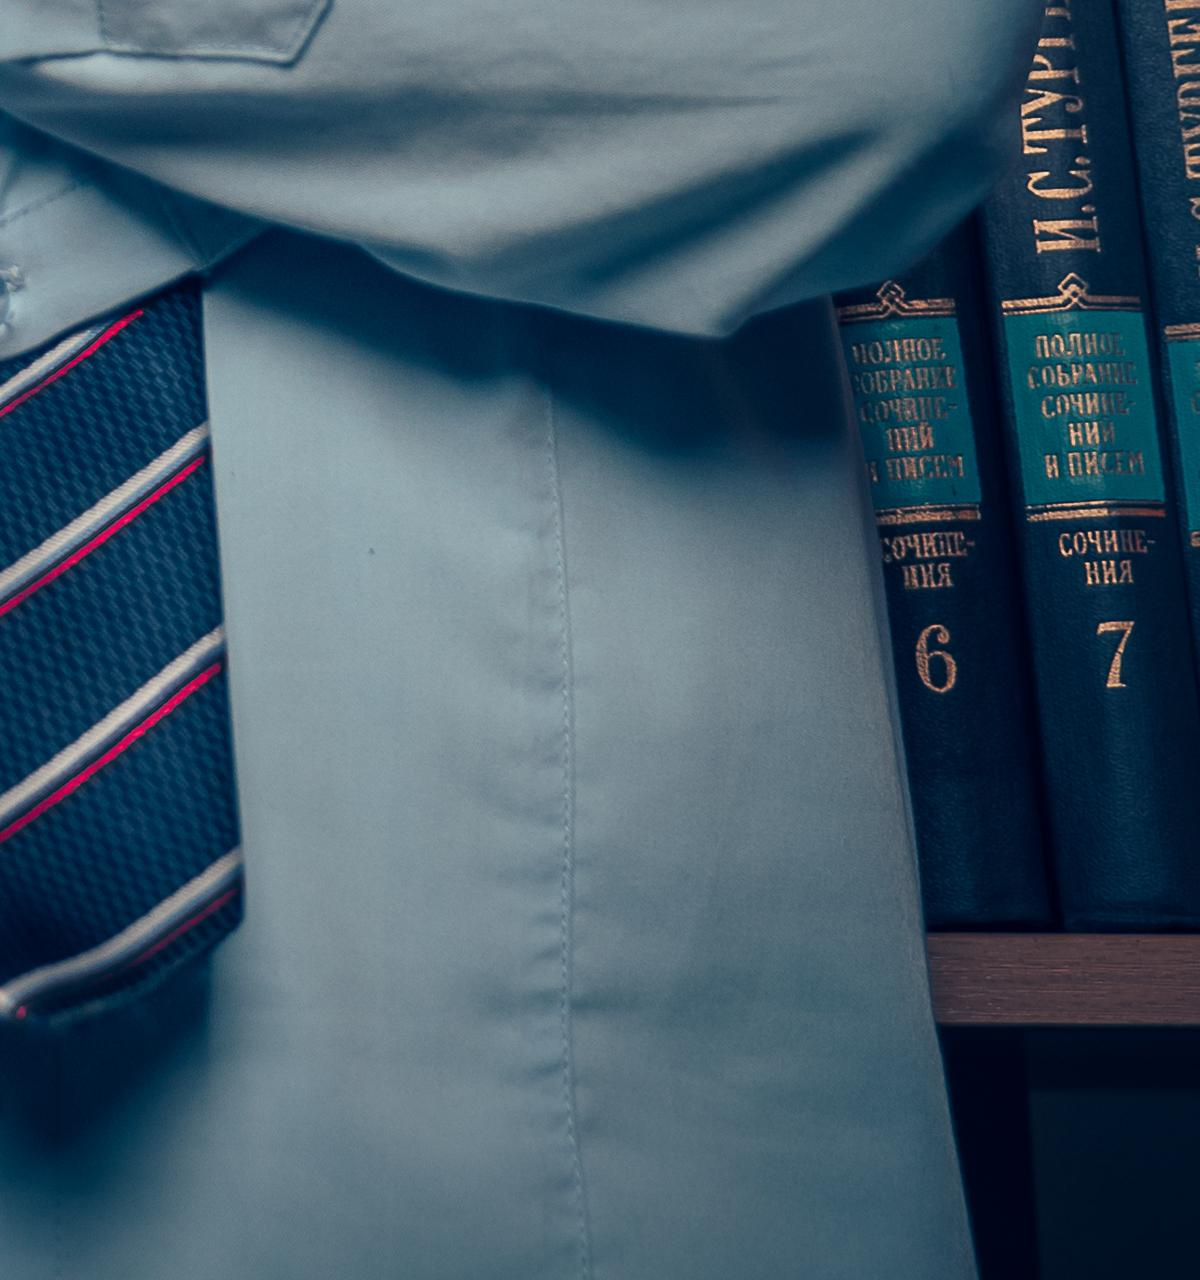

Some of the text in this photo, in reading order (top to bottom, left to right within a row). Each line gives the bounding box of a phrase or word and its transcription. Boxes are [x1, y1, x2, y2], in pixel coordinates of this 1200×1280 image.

[1035, 332, 1126, 359] ПОЛНОЕ
[1027, 361, 1137, 389] СОБРАНИЕ
[1041, 391, 1136, 419] СОЧИНЕ-
[886, 421, 934, 452] НИЙ
[1068, 418, 1116, 447] НИЙ
[886, 455, 964, 481] ПИСЕМ
[1044, 450, 1145, 479] И ПИСЕМ
[1058, 529, 1156, 558] СОЧИНЕ-
[902, 563, 954, 590] НИЯ
[1084, 559, 1134, 586] НИЯ
[915, 624, 957, 693] 6
[1097, 620, 1135, 689] 7
